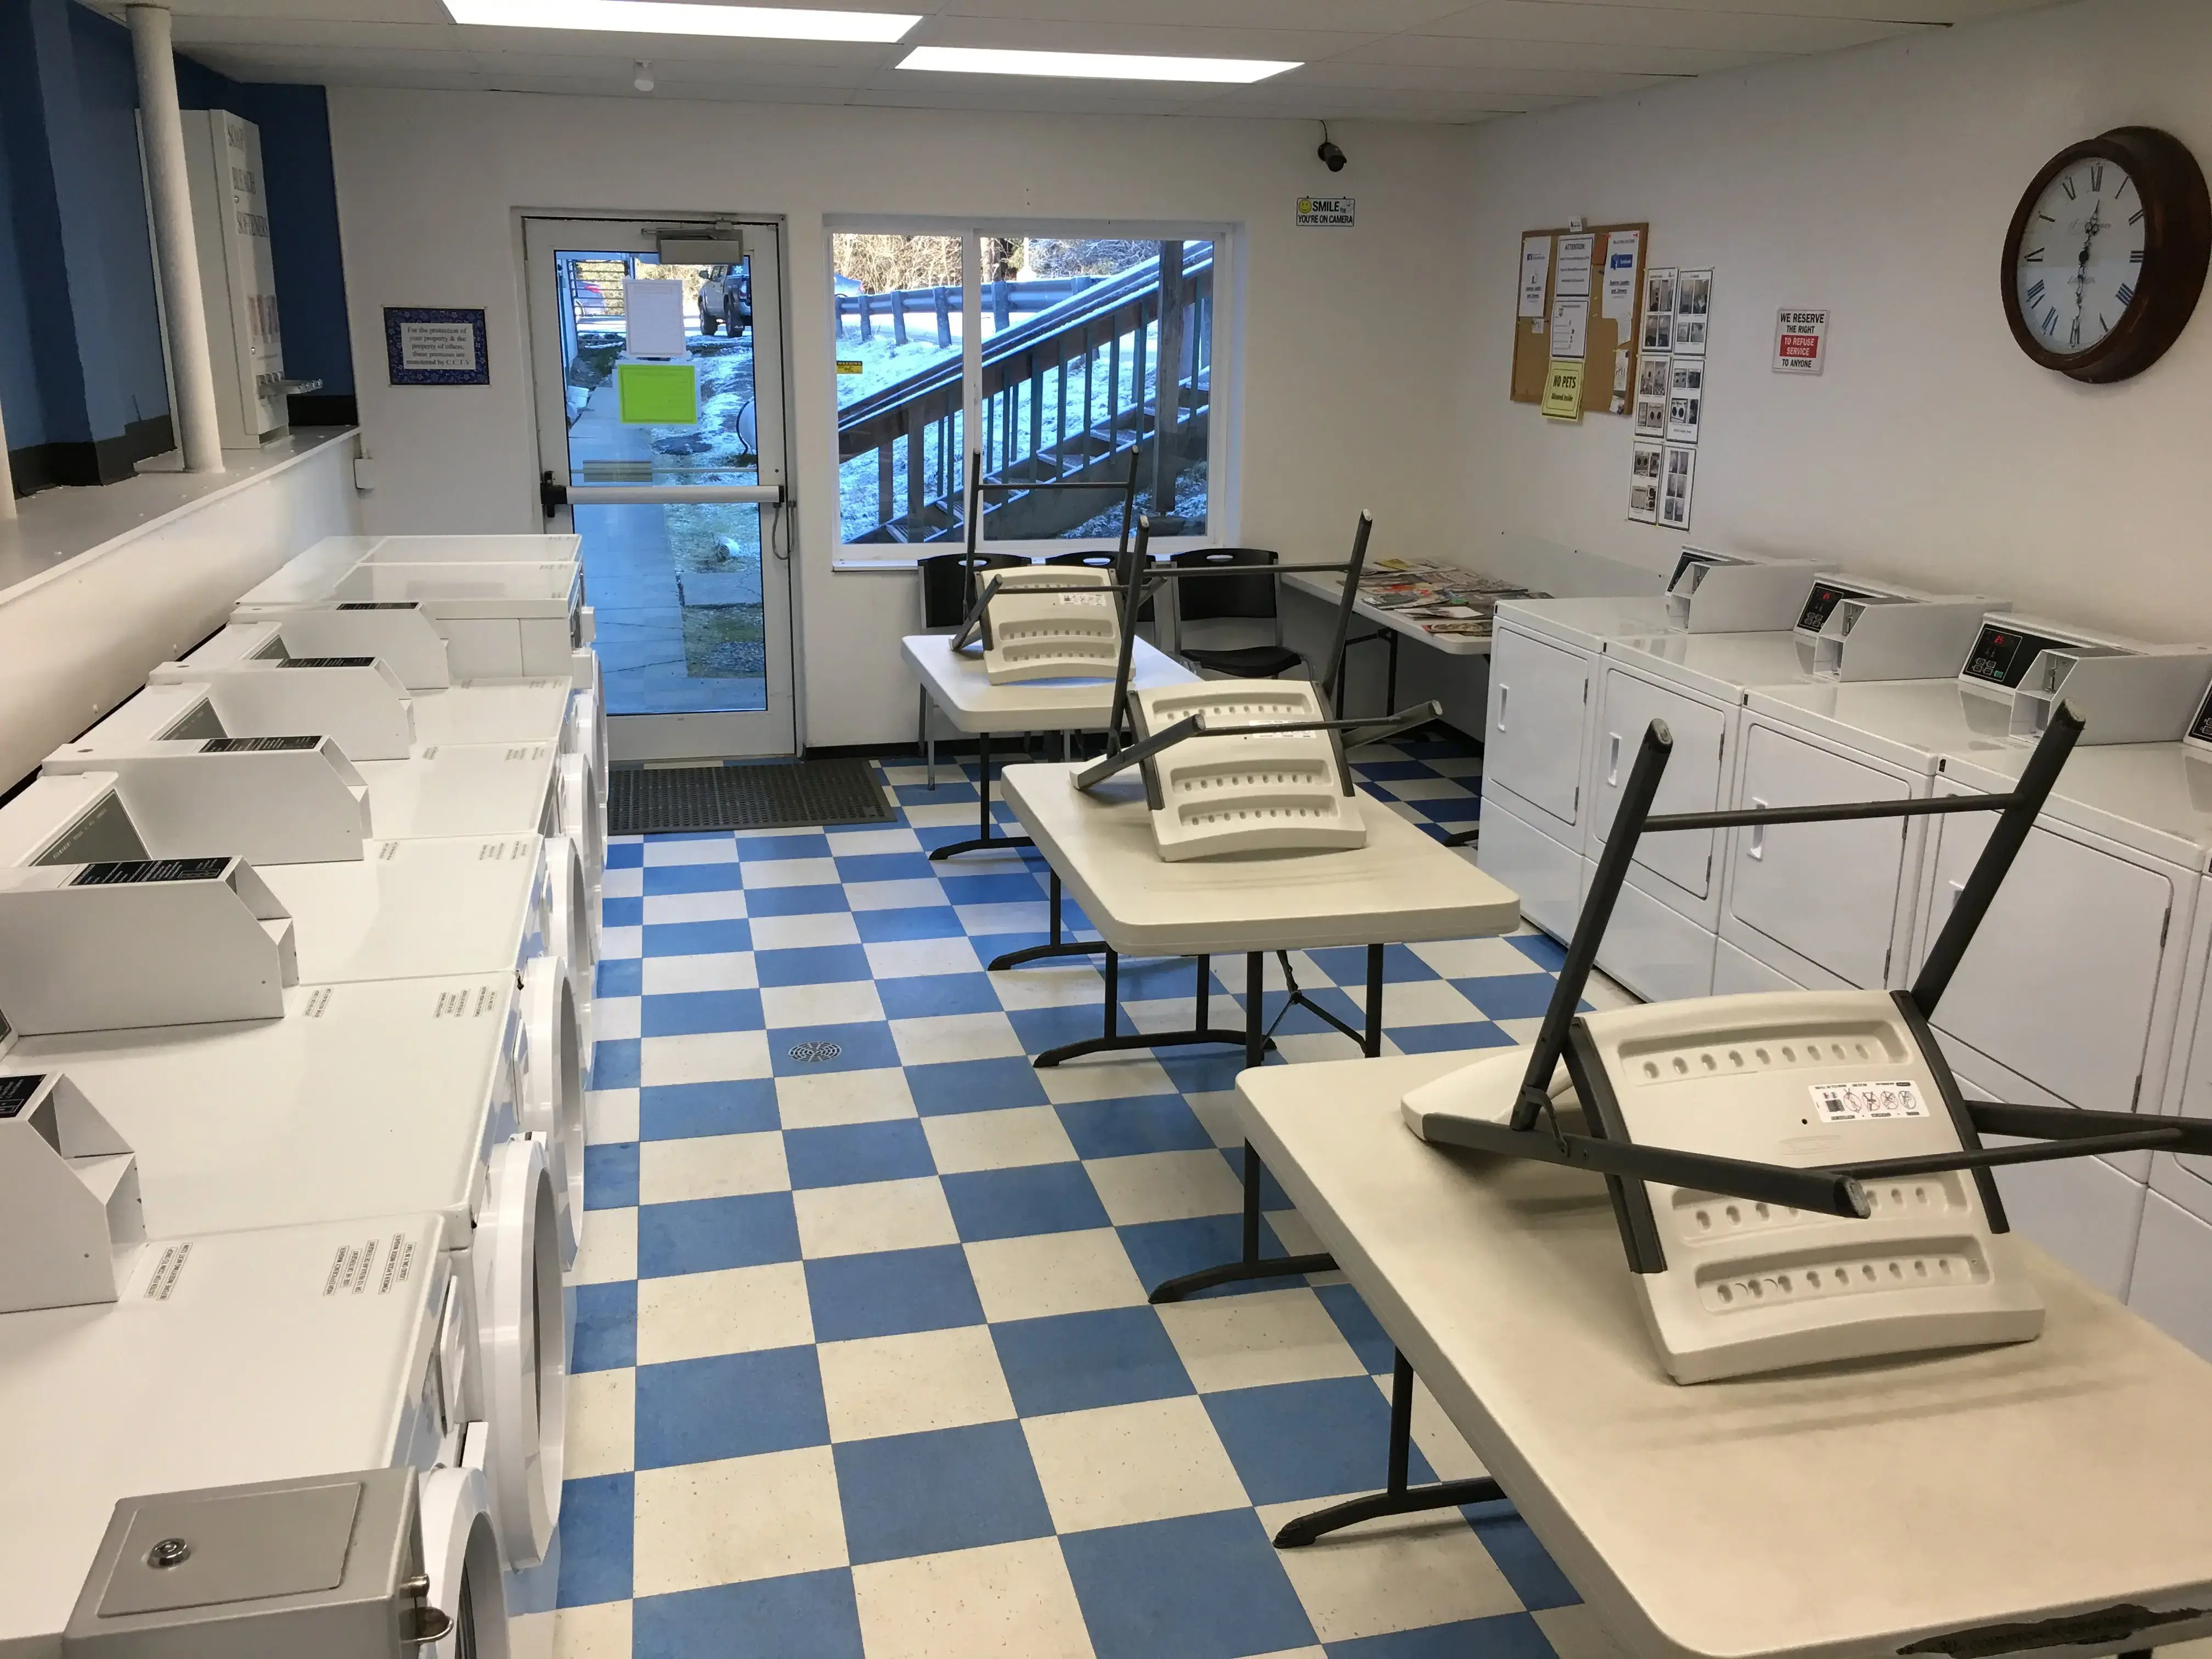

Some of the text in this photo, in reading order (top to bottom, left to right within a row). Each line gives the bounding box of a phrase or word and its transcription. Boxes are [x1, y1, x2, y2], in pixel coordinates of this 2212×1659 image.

[1313, 201, 1339, 212] SMILE
[1298, 215, 1352, 223] YOU'RE ON CAMERA
[1780, 313, 1825, 323] WE RESERVE
[1786, 325, 1815, 334] THE RIGHT
[1793, 337, 1814, 346] REFUSE
[1786, 347, 1810, 356] SERVICE
[1790, 359, 1812, 368] ANYONE
[1553, 375, 1576, 388] NO PETS
[347, 1251, 358, 1272] DETERGENT
[359, 1263, 369, 1280] REGULAR
[364, 1242, 375, 1262] DETERGENT
[381, 1277, 391, 1293] POWDER
[393, 1234, 402, 1250] WASHER
[148, 1284, 158, 1296] LISTEN
[157, 1266, 167, 1274] COIN
[165, 1249, 173, 1259] DROP
[160, 1245, 189, 1299] BEFORE INSERTING NEXT COIN
[326, 1248, 346, 1294] HIGH EFFICIENCY WASHER
[399, 1268, 407, 1280] LIQUID
